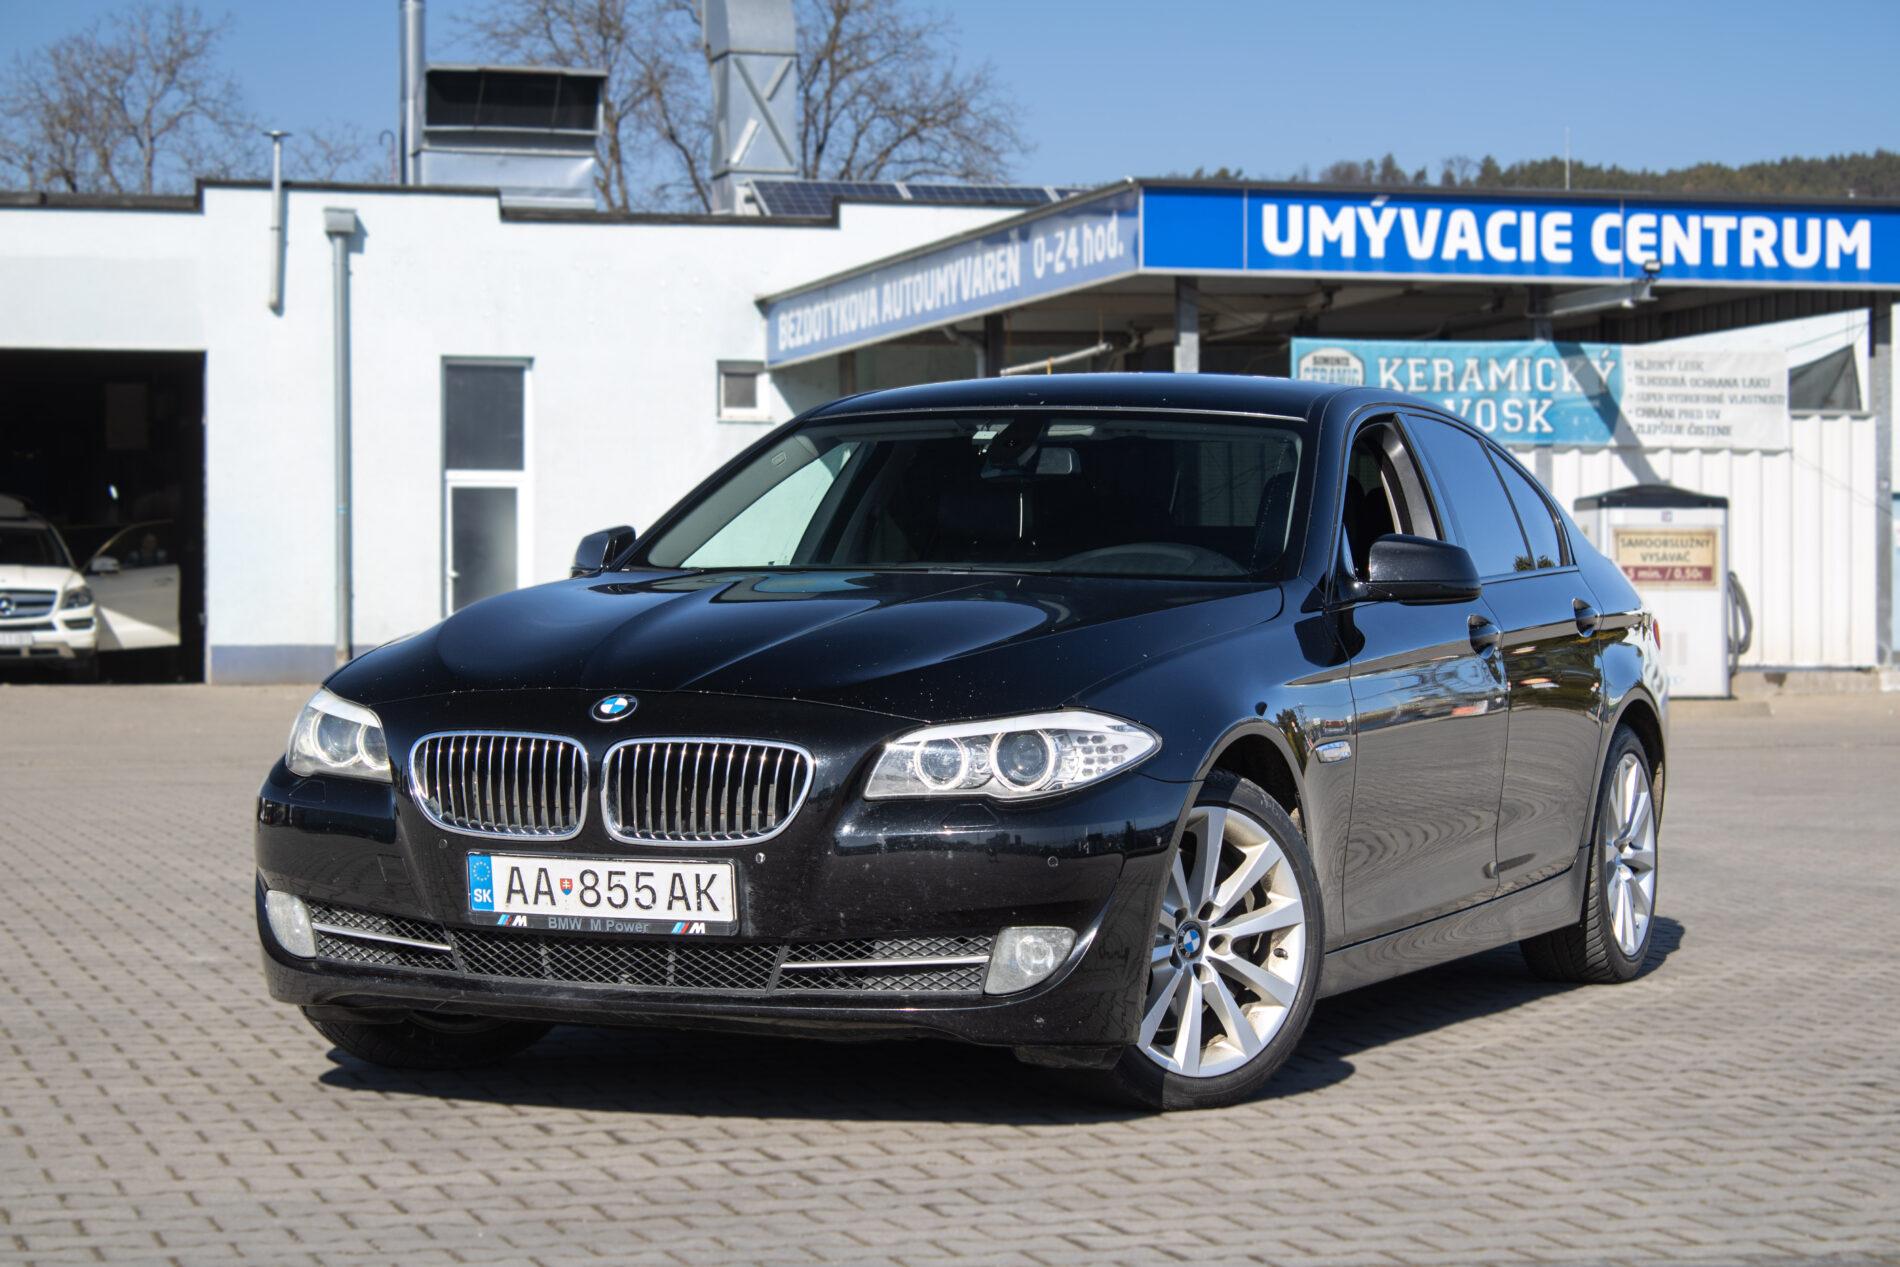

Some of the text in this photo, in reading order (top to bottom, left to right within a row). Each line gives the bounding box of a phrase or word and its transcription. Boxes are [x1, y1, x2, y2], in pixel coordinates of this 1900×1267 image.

[1033, 226, 1079, 279] 0-24
[1082, 209, 1125, 267] hod.
[1262, 195, 1871, 269] UMÝVACIE CENTRUM
[1377, 349, 1616, 393] KERAMICKÝ
[473, 888, 492, 903] SK
[505, 866, 721, 912] AA 855AK
[548, 916, 649, 933] BMW M Power
